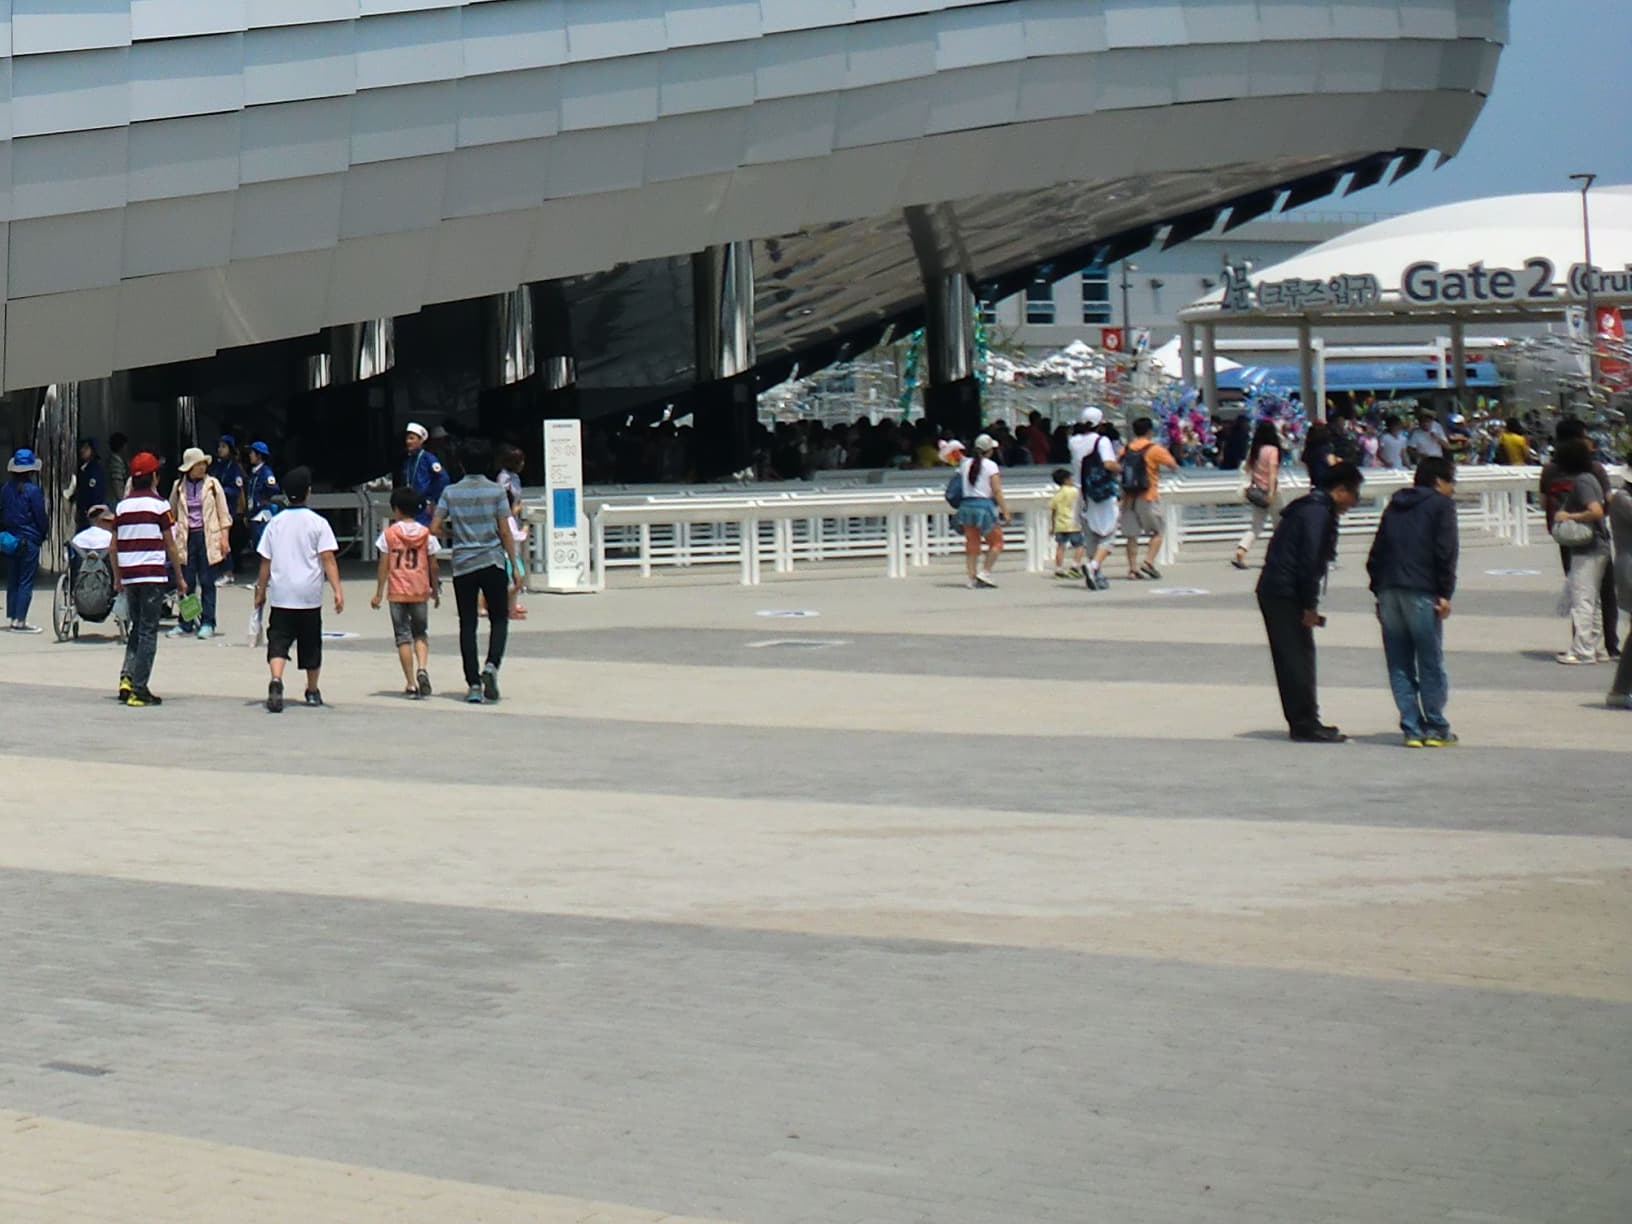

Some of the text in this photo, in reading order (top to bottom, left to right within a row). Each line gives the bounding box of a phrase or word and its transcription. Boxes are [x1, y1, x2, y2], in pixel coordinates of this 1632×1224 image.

[1328, 275, 1379, 305] 입구)
[1404, 262, 1516, 302] Gate
[1527, 259, 1555, 298] 2
[391, 548, 418, 569] 79
